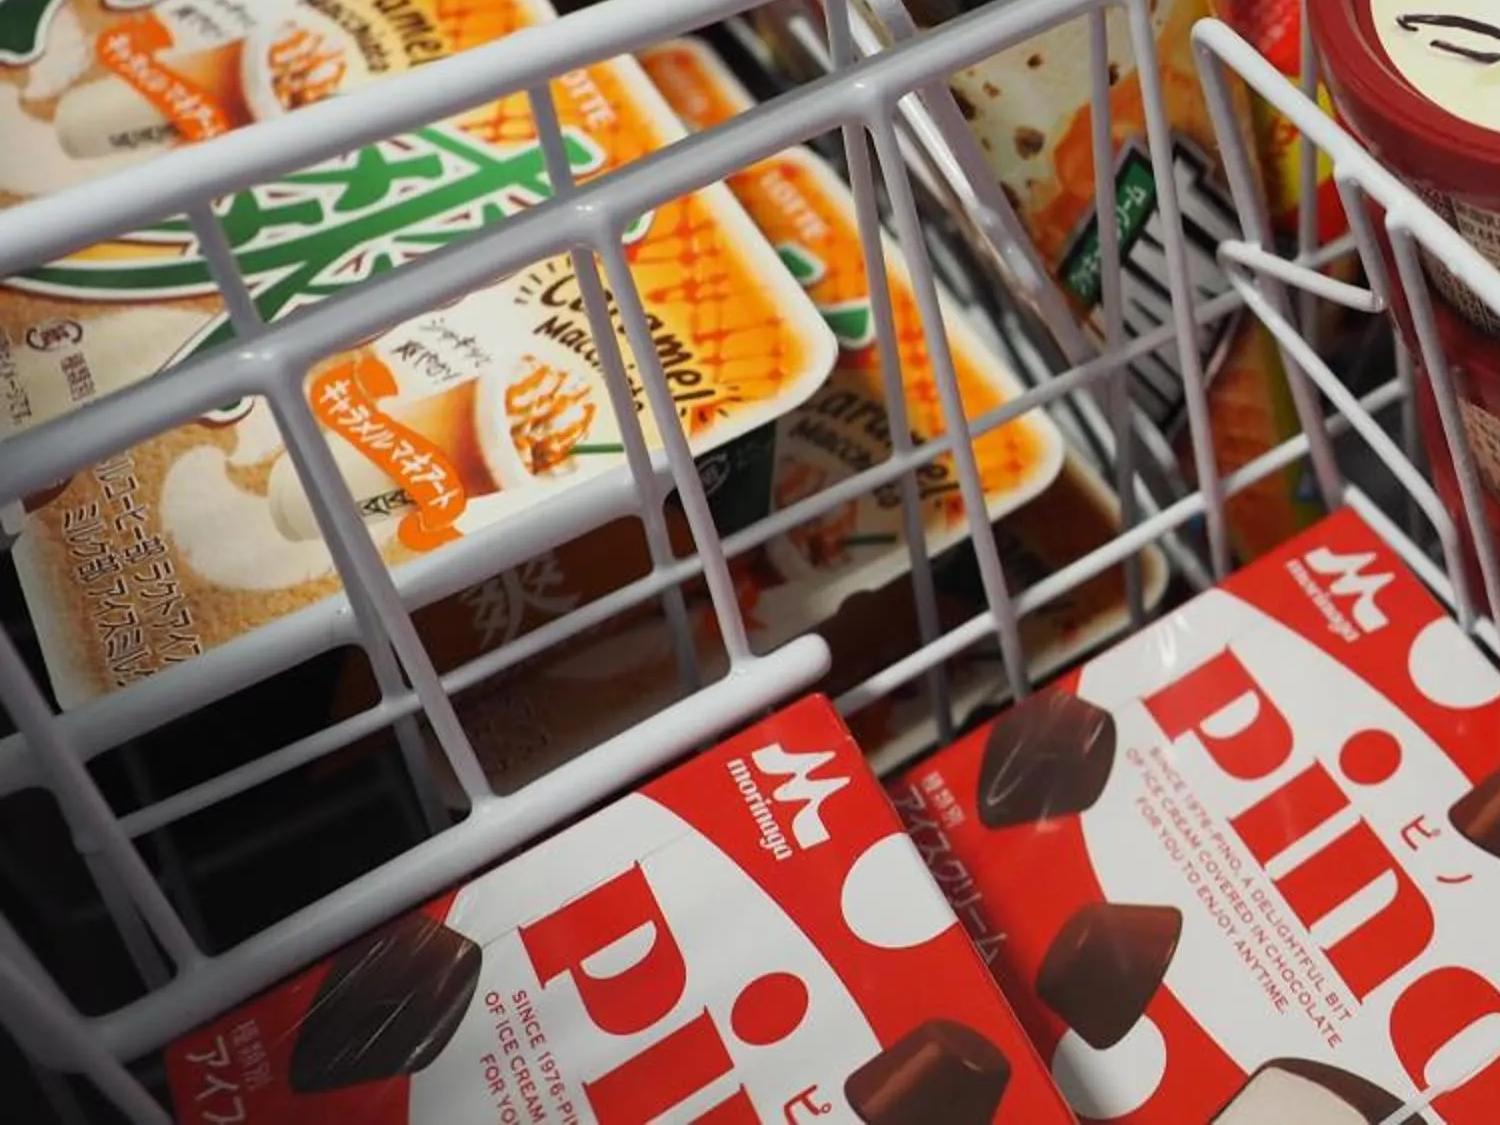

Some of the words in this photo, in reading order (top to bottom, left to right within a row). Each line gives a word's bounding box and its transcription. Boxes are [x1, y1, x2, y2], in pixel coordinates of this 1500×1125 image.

[1284, 559, 1360, 643] morinaga
[725, 758, 794, 863] morinaga
[892, 785, 1009, 965] アイスクリーム
[1132, 795, 1163, 830] FOR
[1154, 827, 1186, 863] YOU
[1179, 861, 1202, 886] TO
[1193, 883, 1241, 939] ENJOY
[1157, 795, 1203, 851] CREAM
[1193, 848, 1257, 926] COVERED
[1259, 943, 1345, 1050] CHOCOLATE
[1247, 887, 1331, 991] DELIGHTFUL
[1322, 991, 1352, 1025] BIT
[481, 988, 506, 1017] OF
[492, 1019, 520, 1054] ICE
[507, 987, 549, 1049] SINCE
[475, 1052, 508, 1095] FOR
